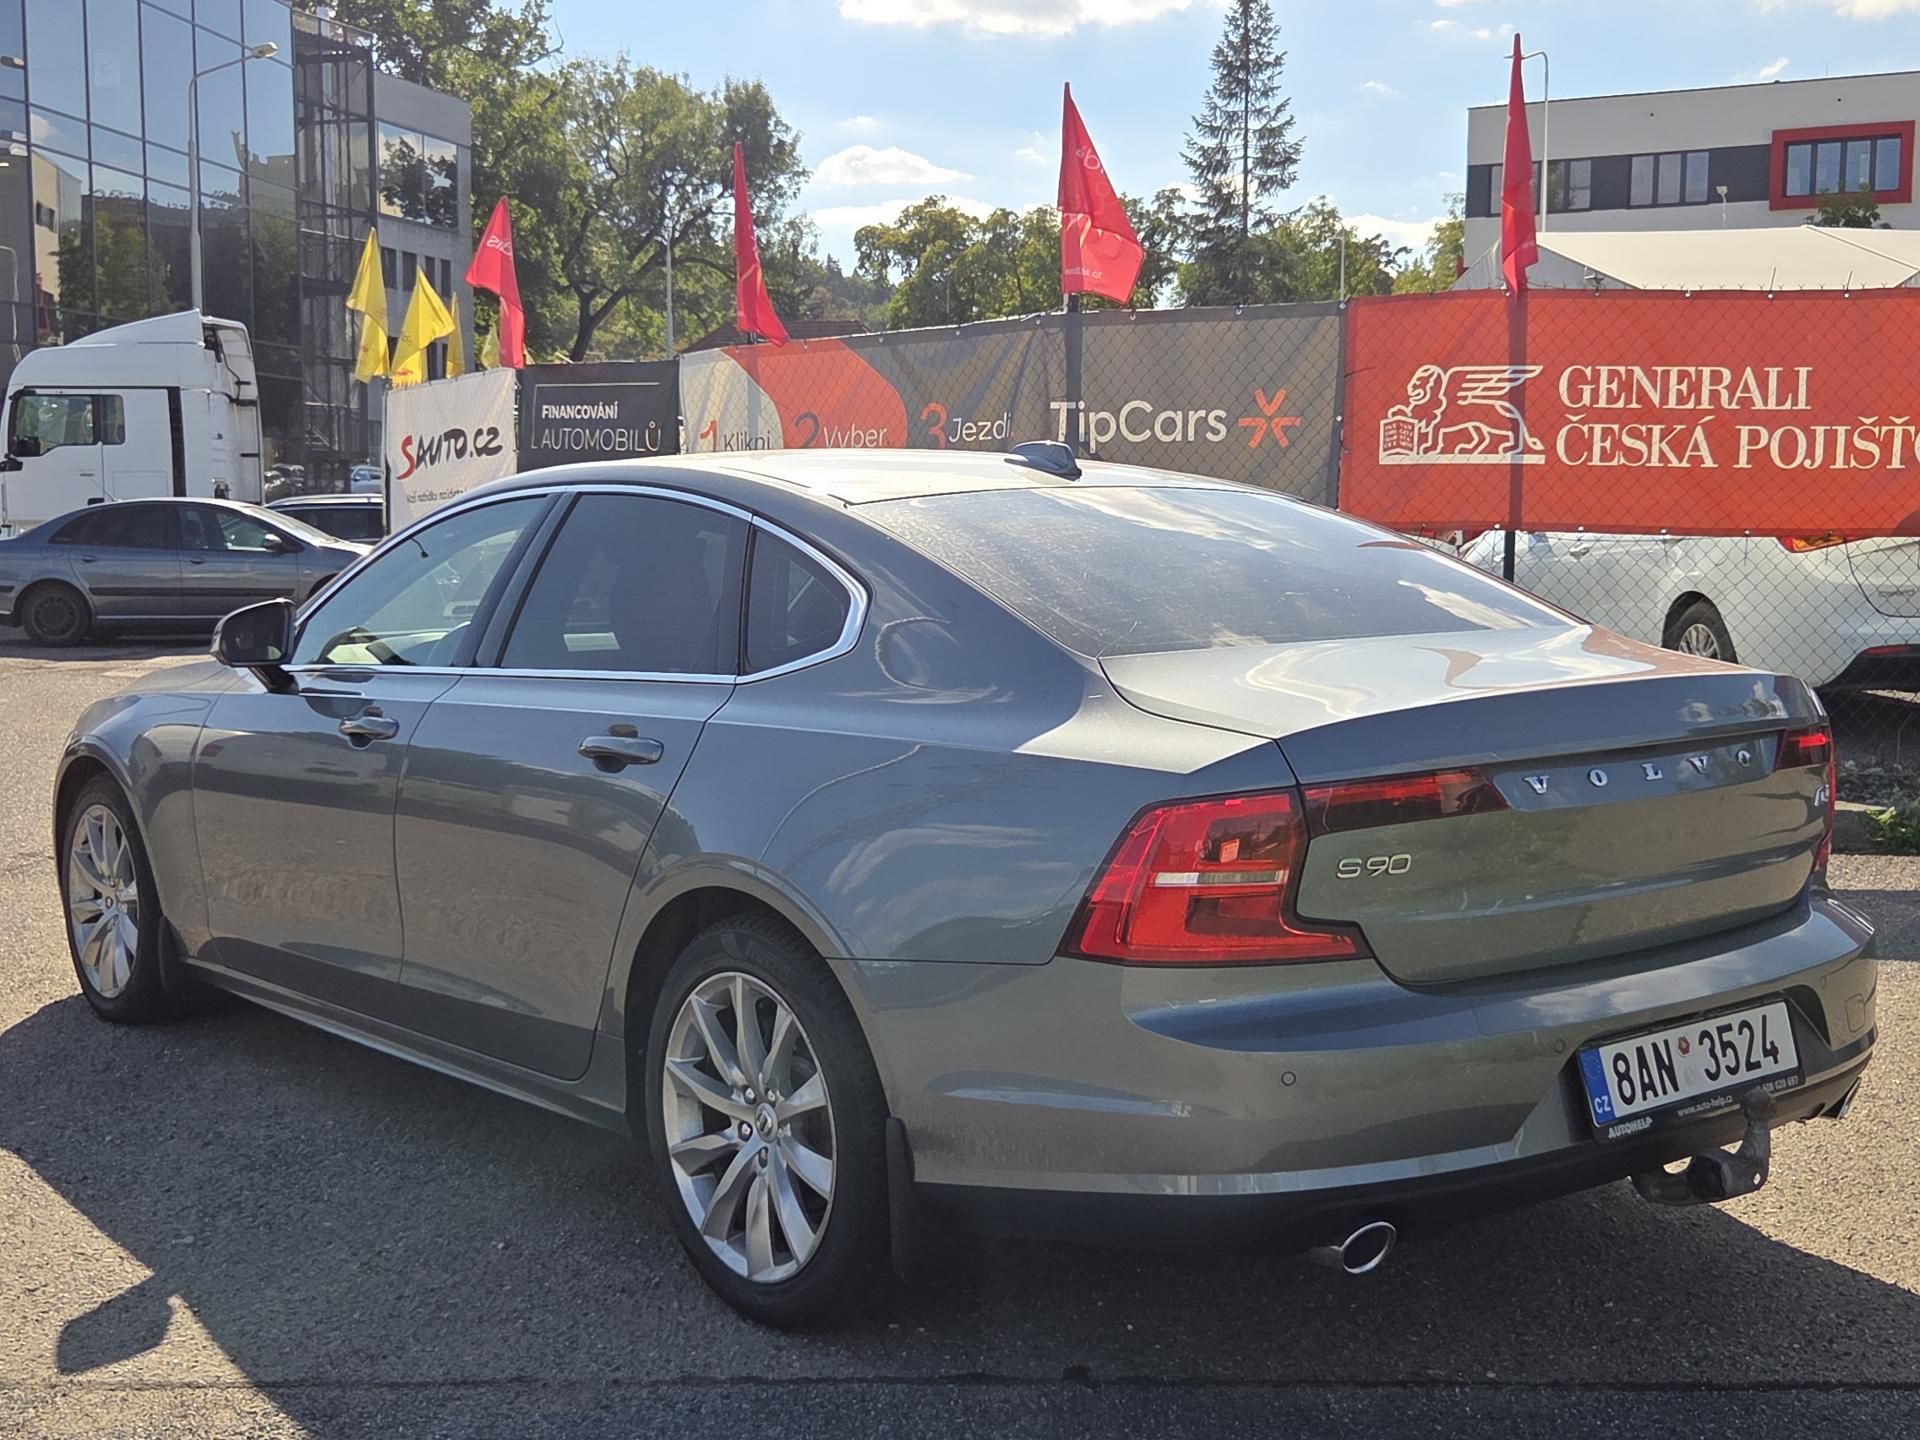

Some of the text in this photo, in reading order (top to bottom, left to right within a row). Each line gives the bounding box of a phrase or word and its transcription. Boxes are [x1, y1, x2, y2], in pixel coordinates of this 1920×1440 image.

[1558, 364, 1814, 411] GENERALI
[542, 401, 618, 419] FINANCOVÁNÍ
[794, 412, 820, 449] 2
[920, 402, 948, 450] 3
[1050, 400, 1227, 454] TipCars
[541, 420, 661, 452] AUTOMOBILŮ
[700, 420, 717, 451] 1
[1556, 415, 1920, 470] ČESKÁ POJIŠŤ
[1524, 749, 1751, 794] VOLVO
[1336, 853, 1412, 879] S90
[1612, 1014, 1779, 1106] 8AN 3524
[1594, 1094, 1612, 1115] CZ
